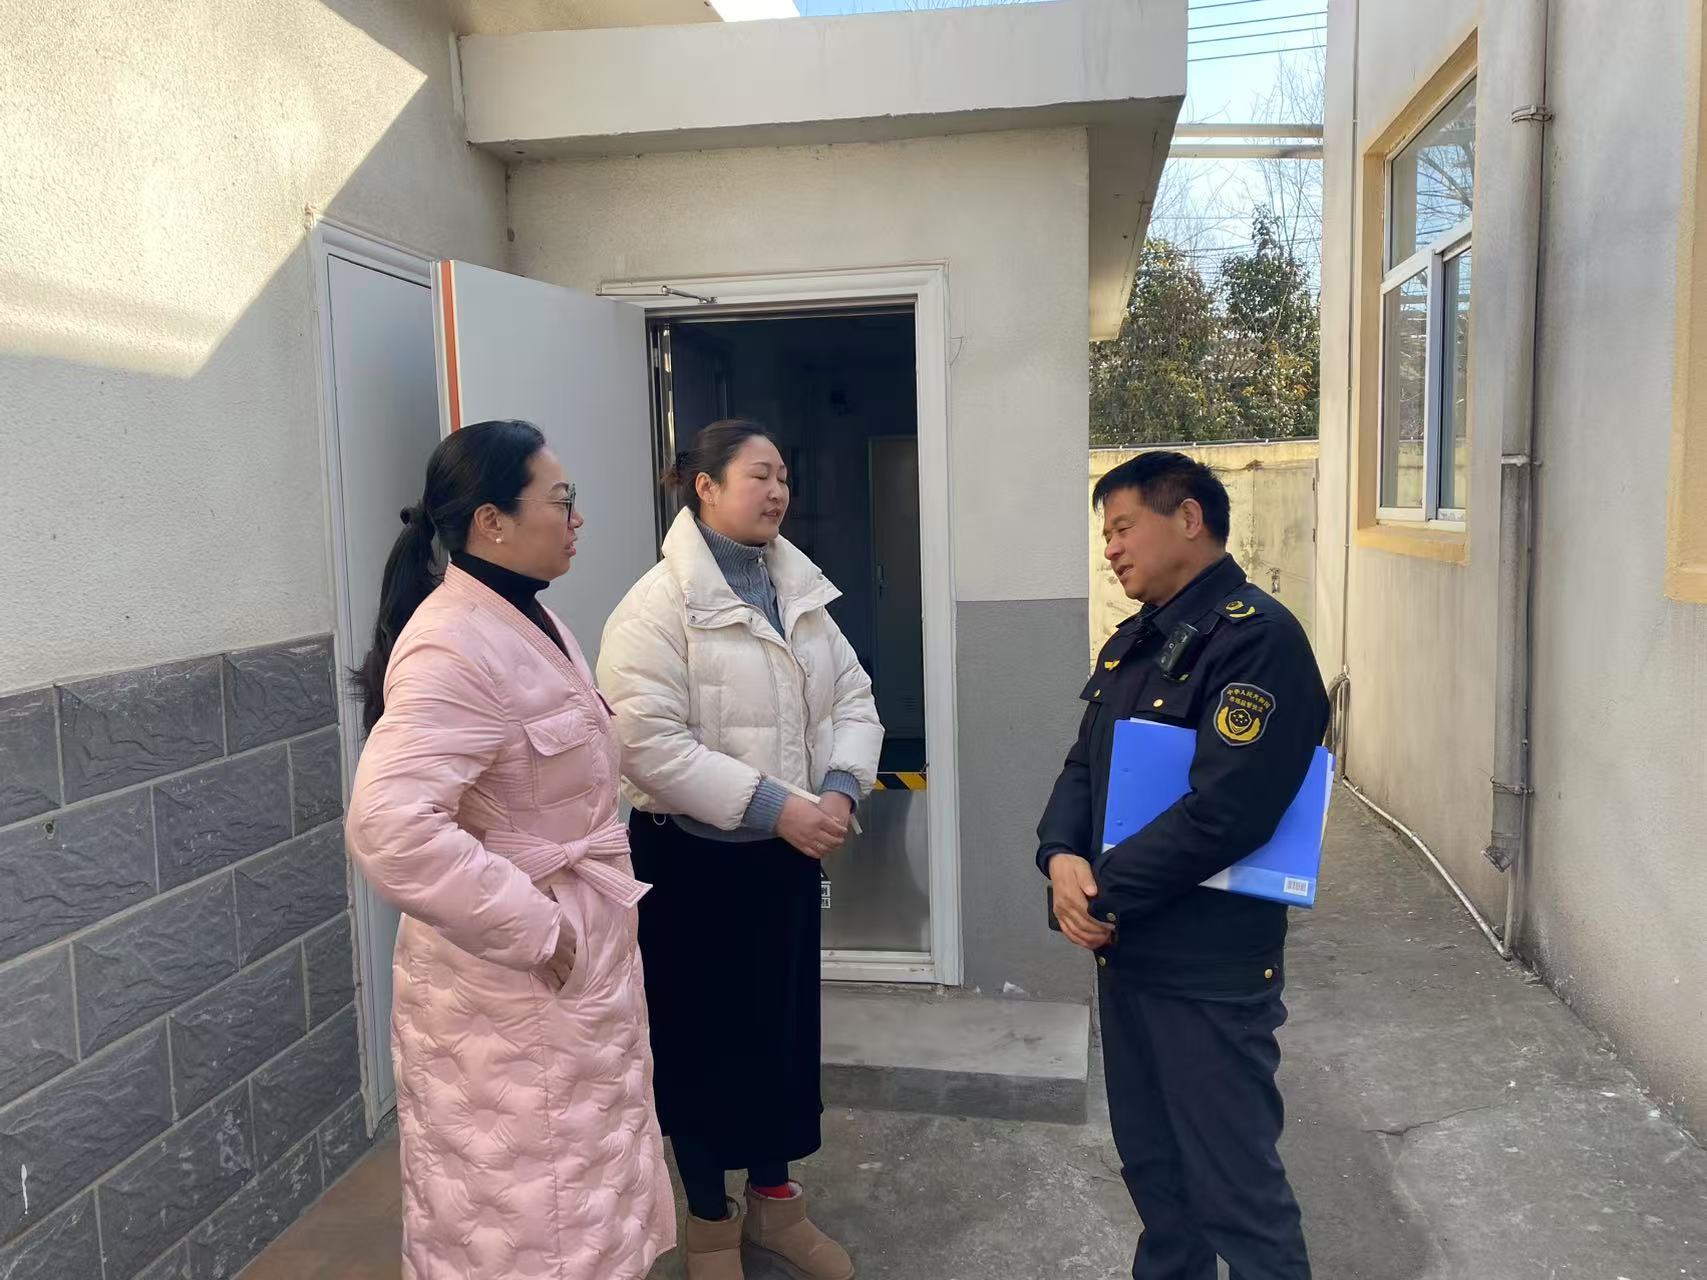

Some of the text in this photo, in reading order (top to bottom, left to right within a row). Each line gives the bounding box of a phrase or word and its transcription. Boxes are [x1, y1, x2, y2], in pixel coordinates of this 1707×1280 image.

[1226, 688, 1271, 709] 中华人民共和国
